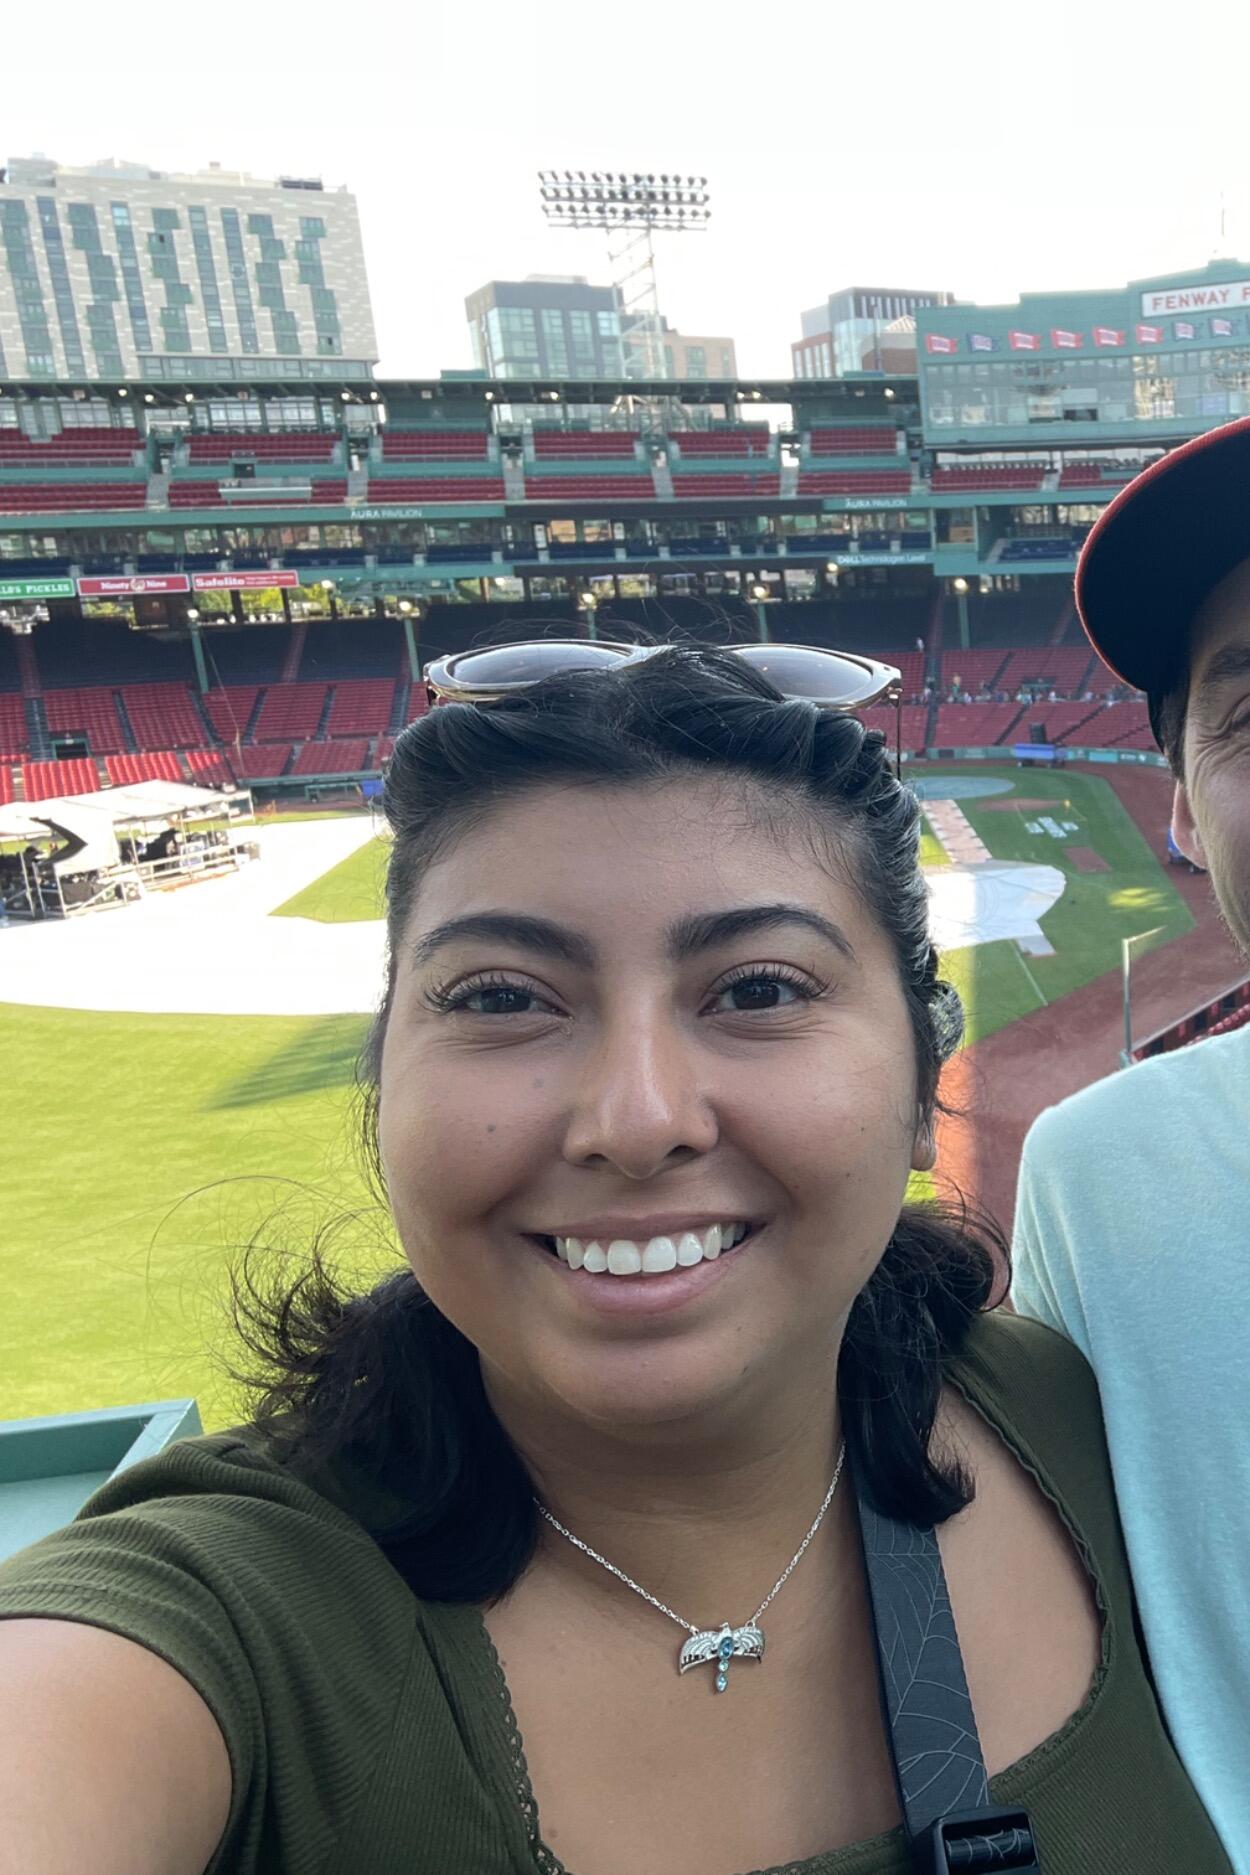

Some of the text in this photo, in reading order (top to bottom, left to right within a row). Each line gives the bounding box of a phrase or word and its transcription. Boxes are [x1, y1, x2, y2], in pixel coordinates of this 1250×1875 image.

[1152, 289, 1230, 311] FENWAY
[381, 508, 423, 519] PAVILION
[195, 577, 245, 588] Safelite
[26, 583, 70, 594] PICKLES
